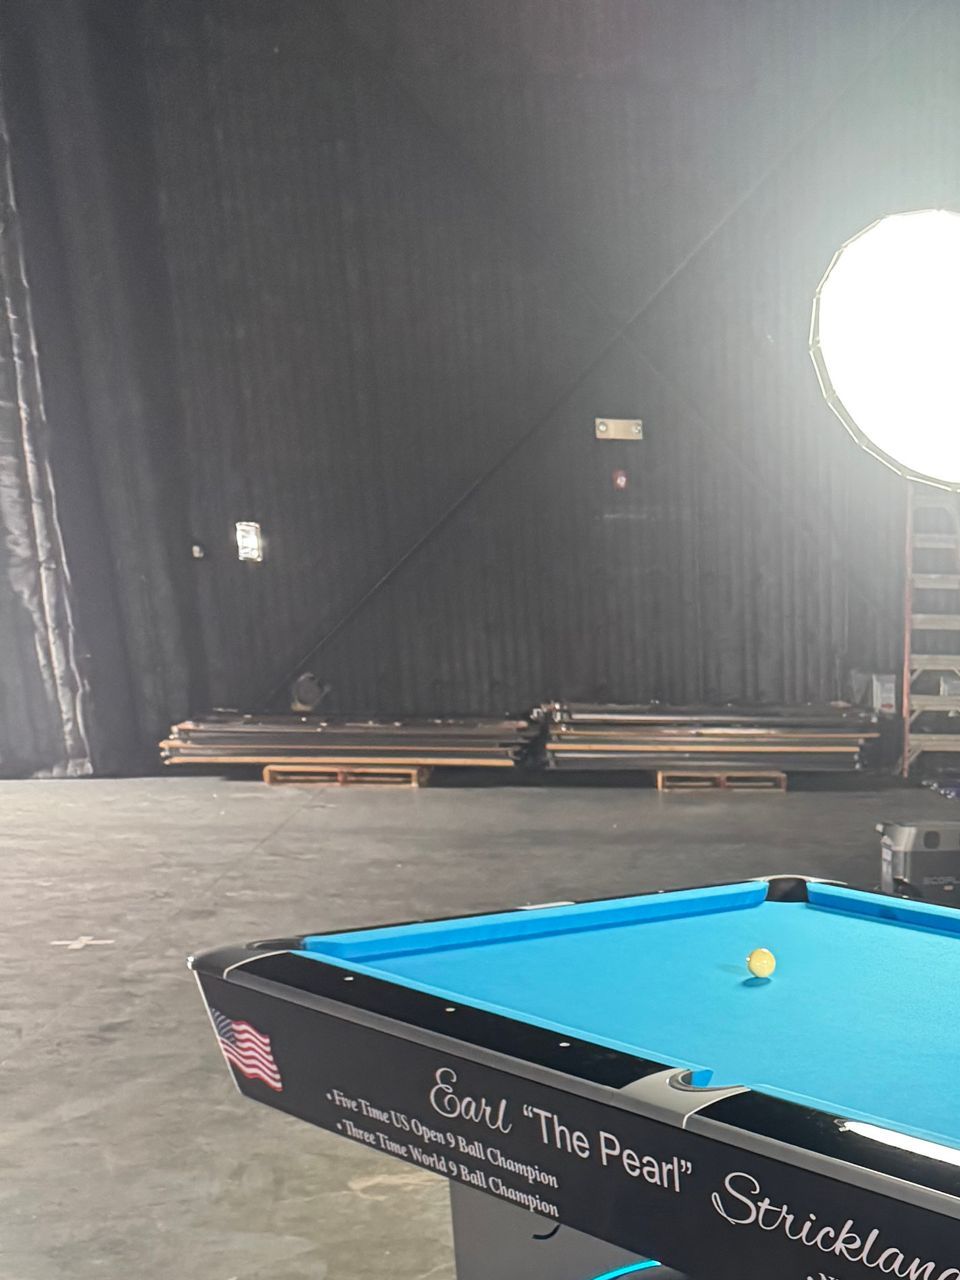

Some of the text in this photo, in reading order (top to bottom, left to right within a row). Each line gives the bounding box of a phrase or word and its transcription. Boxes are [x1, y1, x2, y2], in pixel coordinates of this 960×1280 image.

[332, 1088, 559, 1189] Five Time US Open 9 Ball Champion
[430, 1067, 513, 1134] Earl
[341, 1118, 560, 1218] Three Time World 9 Ball Champion
